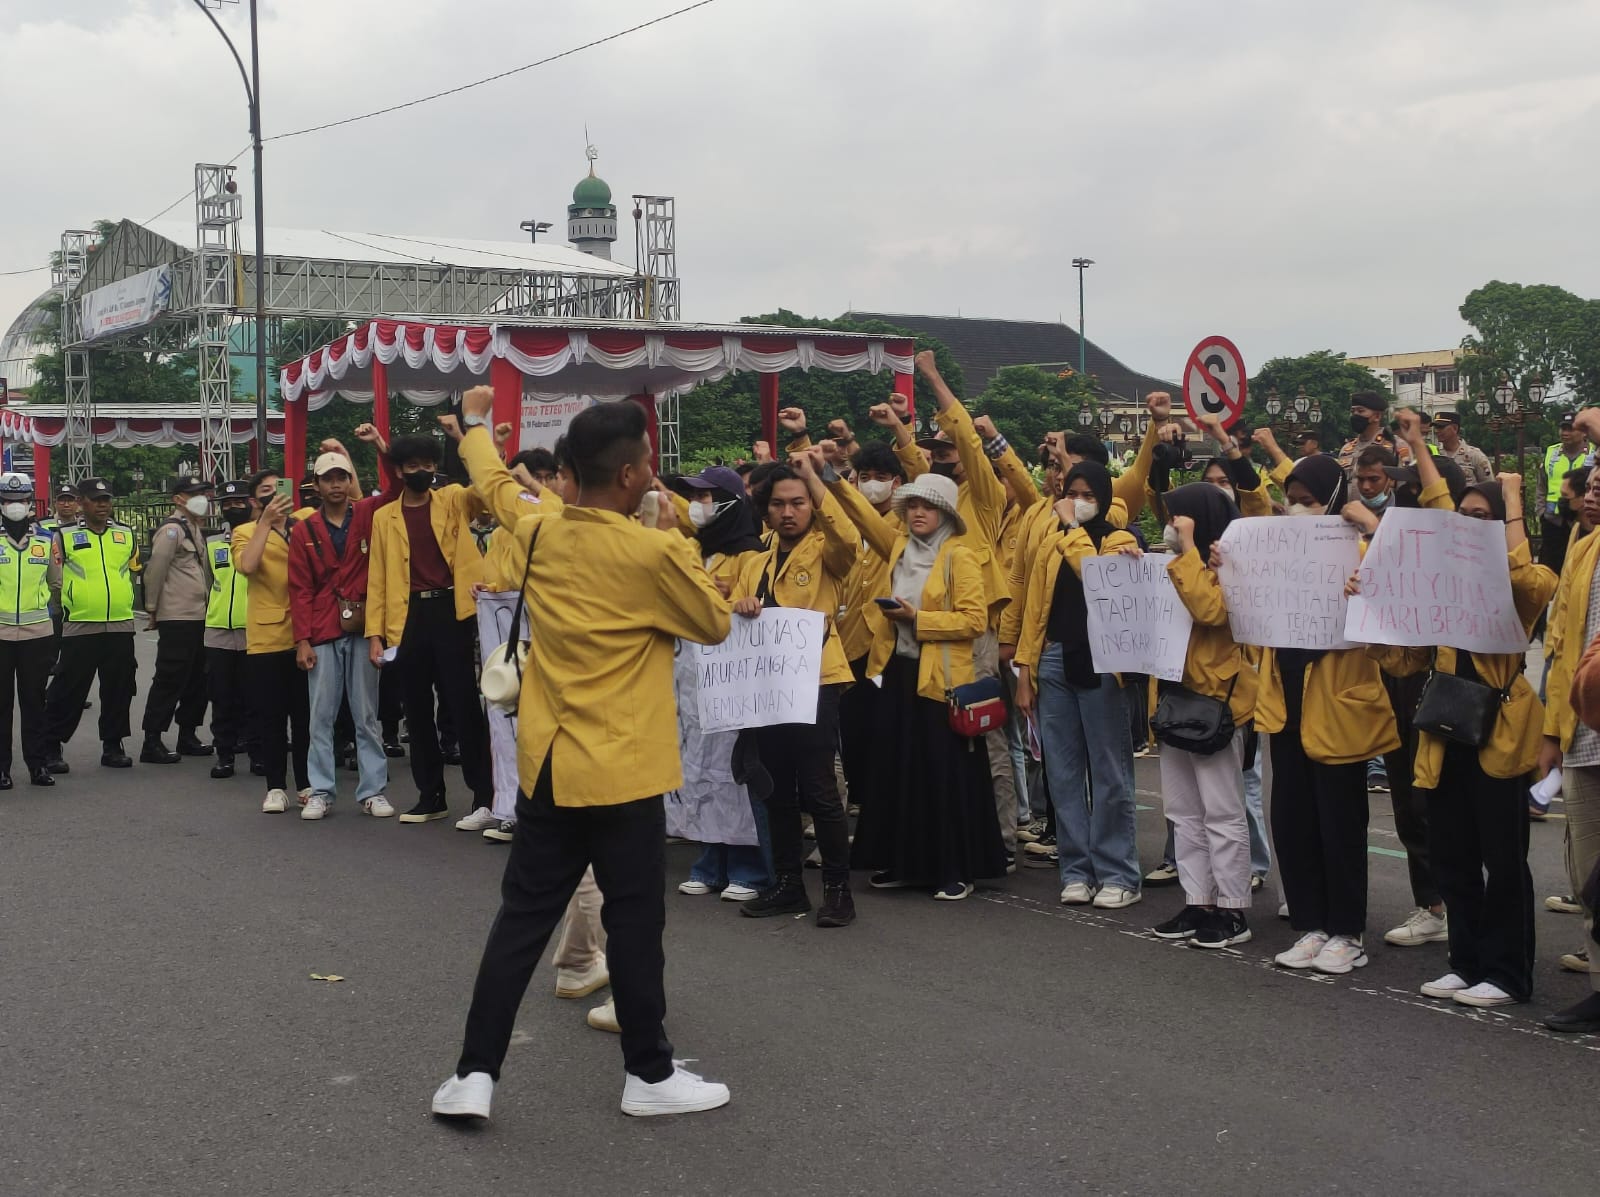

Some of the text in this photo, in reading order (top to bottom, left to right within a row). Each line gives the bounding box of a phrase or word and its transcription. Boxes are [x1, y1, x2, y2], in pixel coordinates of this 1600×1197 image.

[1092, 595, 1138, 622] TAPI
[1224, 584, 1341, 613] PEMERINTAH
[1287, 612, 1338, 629] TEPATI
[1359, 603, 1421, 635] MARI
[1100, 629, 1153, 656] INGKAR
[696, 654, 809, 691] DARURAT ANGKA
[704, 688, 794, 722] KEMISKINAN
